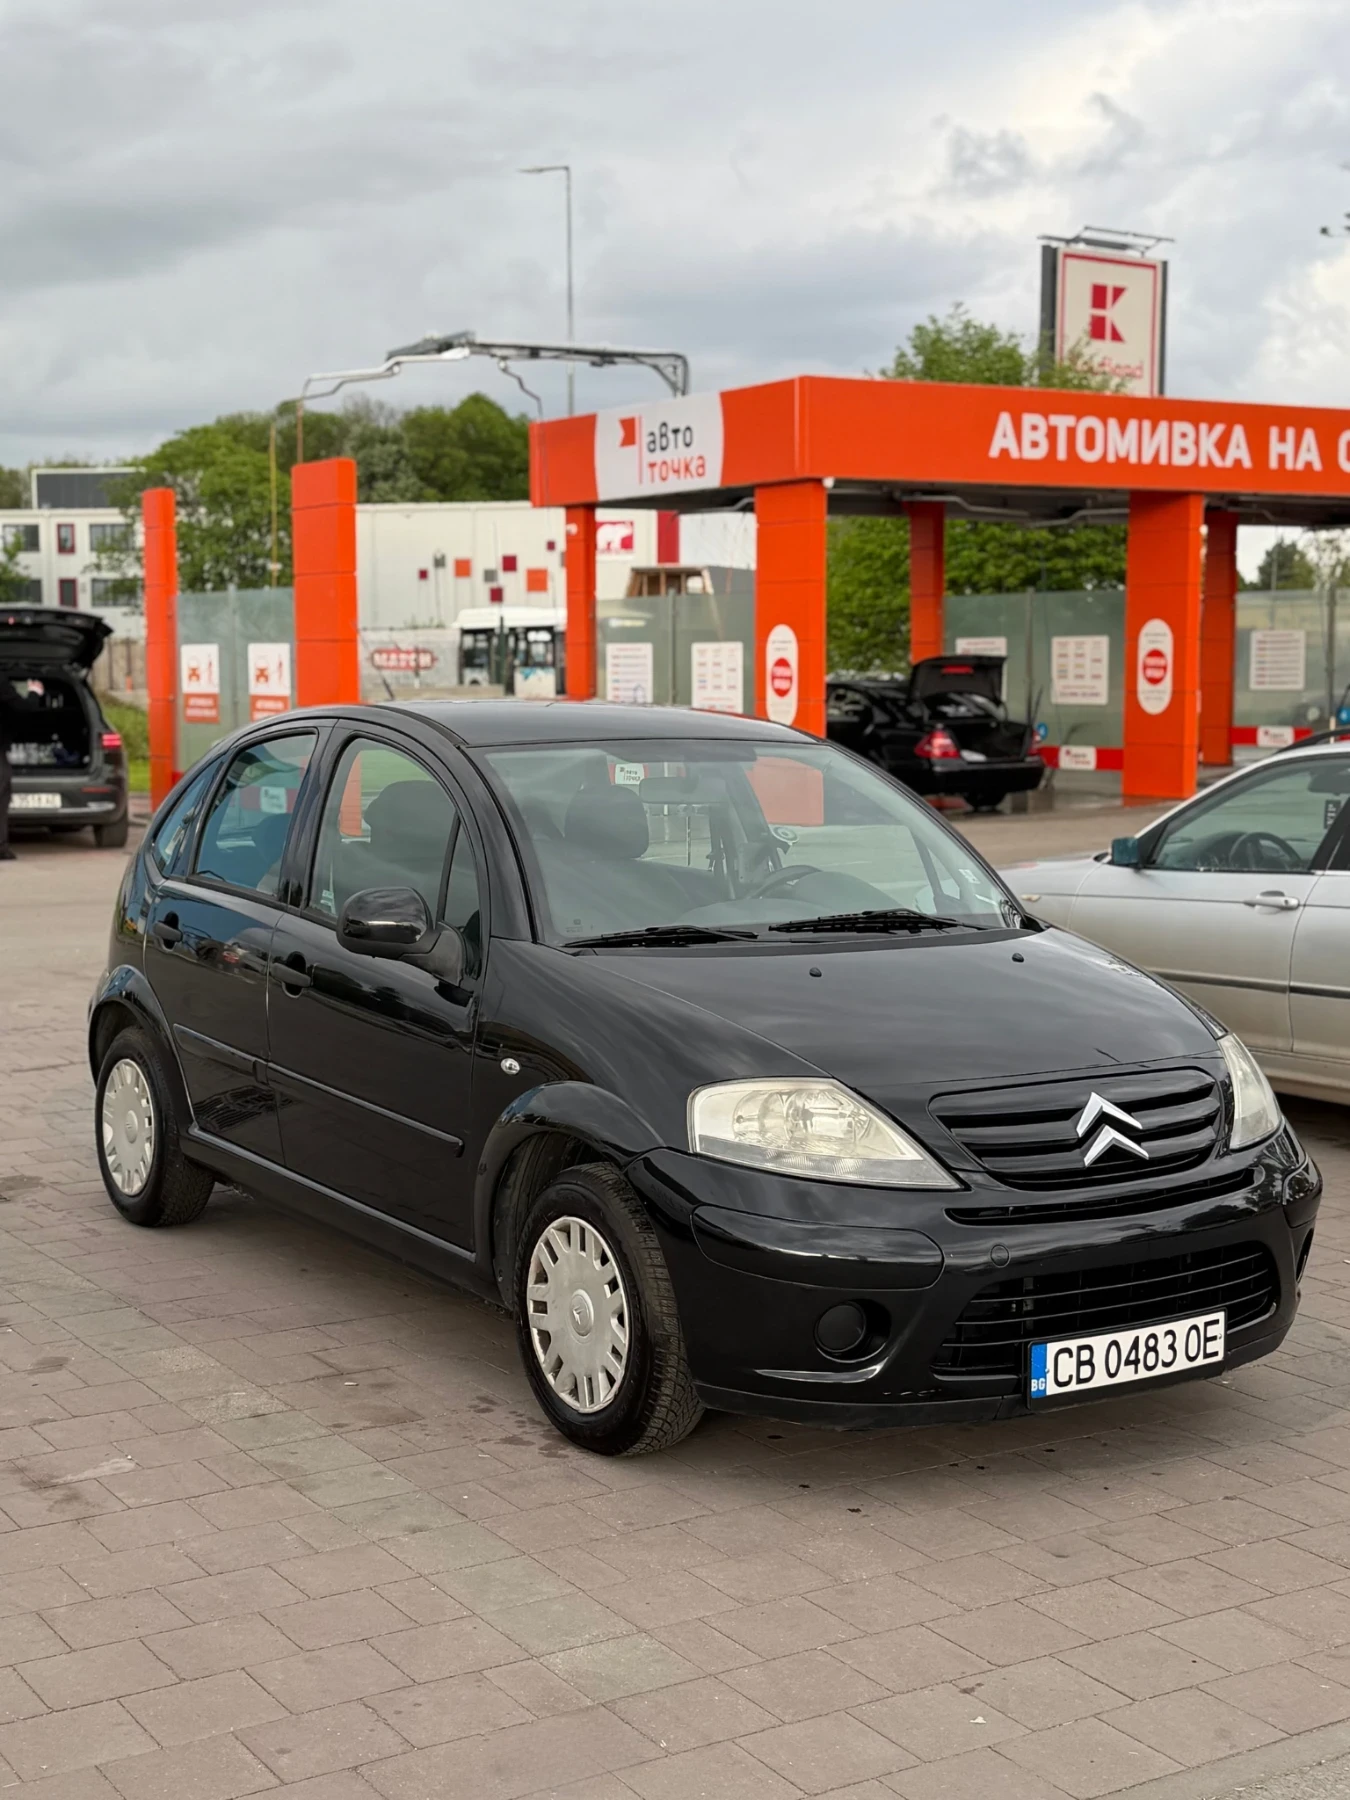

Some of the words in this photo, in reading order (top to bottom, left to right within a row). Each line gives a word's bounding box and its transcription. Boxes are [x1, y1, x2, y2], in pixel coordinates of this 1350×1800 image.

[647, 421, 694, 453] авто
[988, 411, 1253, 470] АВТОМИВКА
[1268, 426, 1323, 472] НА
[647, 454, 706, 484] точка
[1053, 1344, 1096, 1388] CB
[1104, 1329, 1178, 1379] 0483
[1184, 1318, 1220, 1363] OE
[1031, 1378, 1046, 1392] BG
